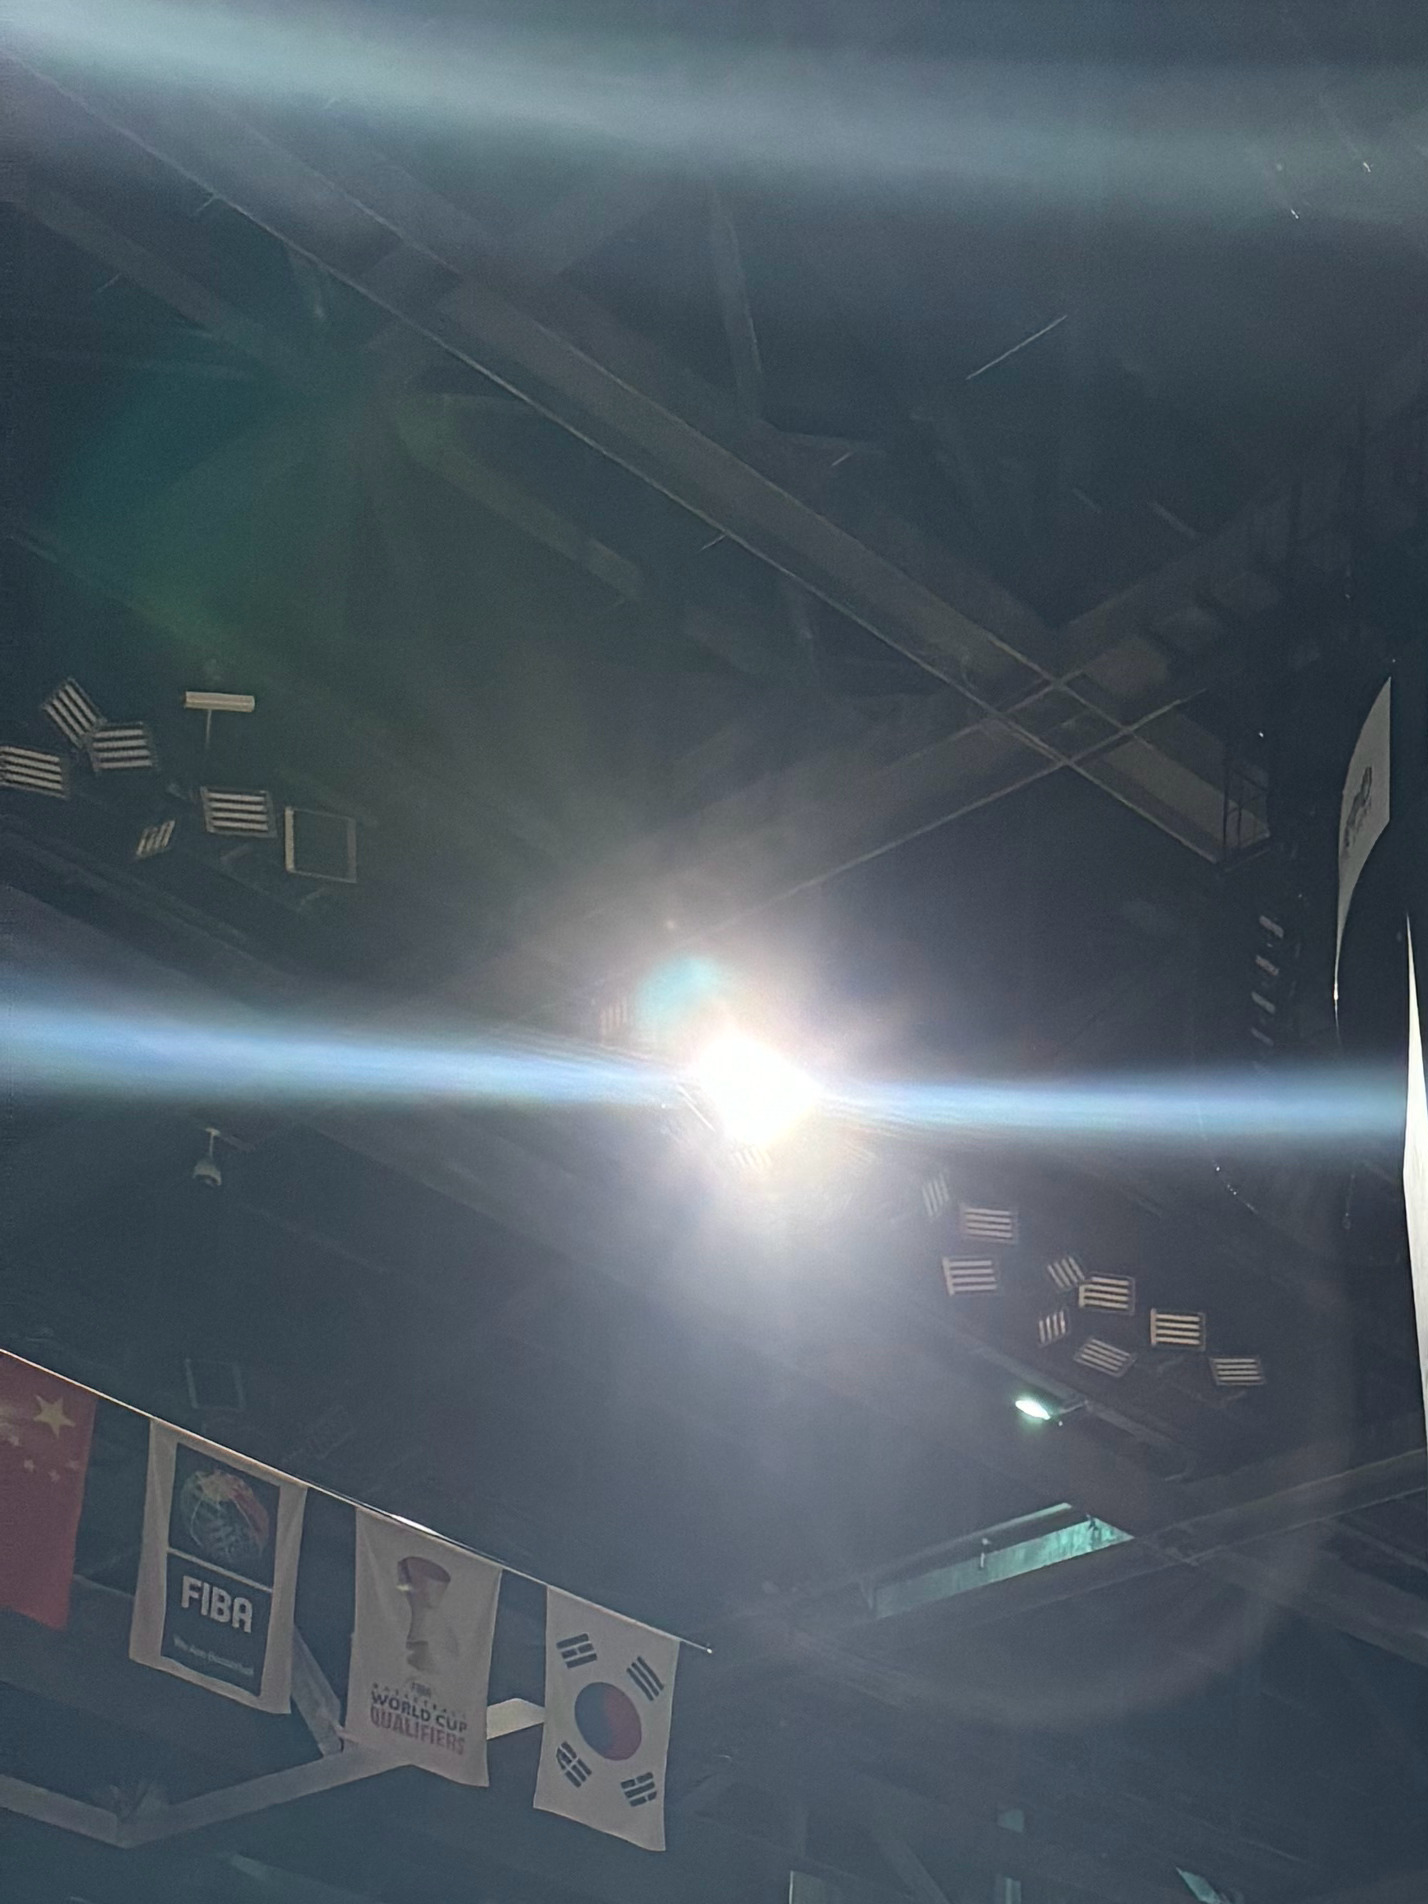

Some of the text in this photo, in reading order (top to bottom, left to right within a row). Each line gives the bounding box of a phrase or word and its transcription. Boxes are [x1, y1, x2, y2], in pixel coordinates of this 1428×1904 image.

[181, 1575, 253, 1633] FIBA
[370, 1704, 465, 1755] QUALIFIERS
[371, 1690, 431, 1722] WORLD
[436, 1714, 468, 1733] CUP
